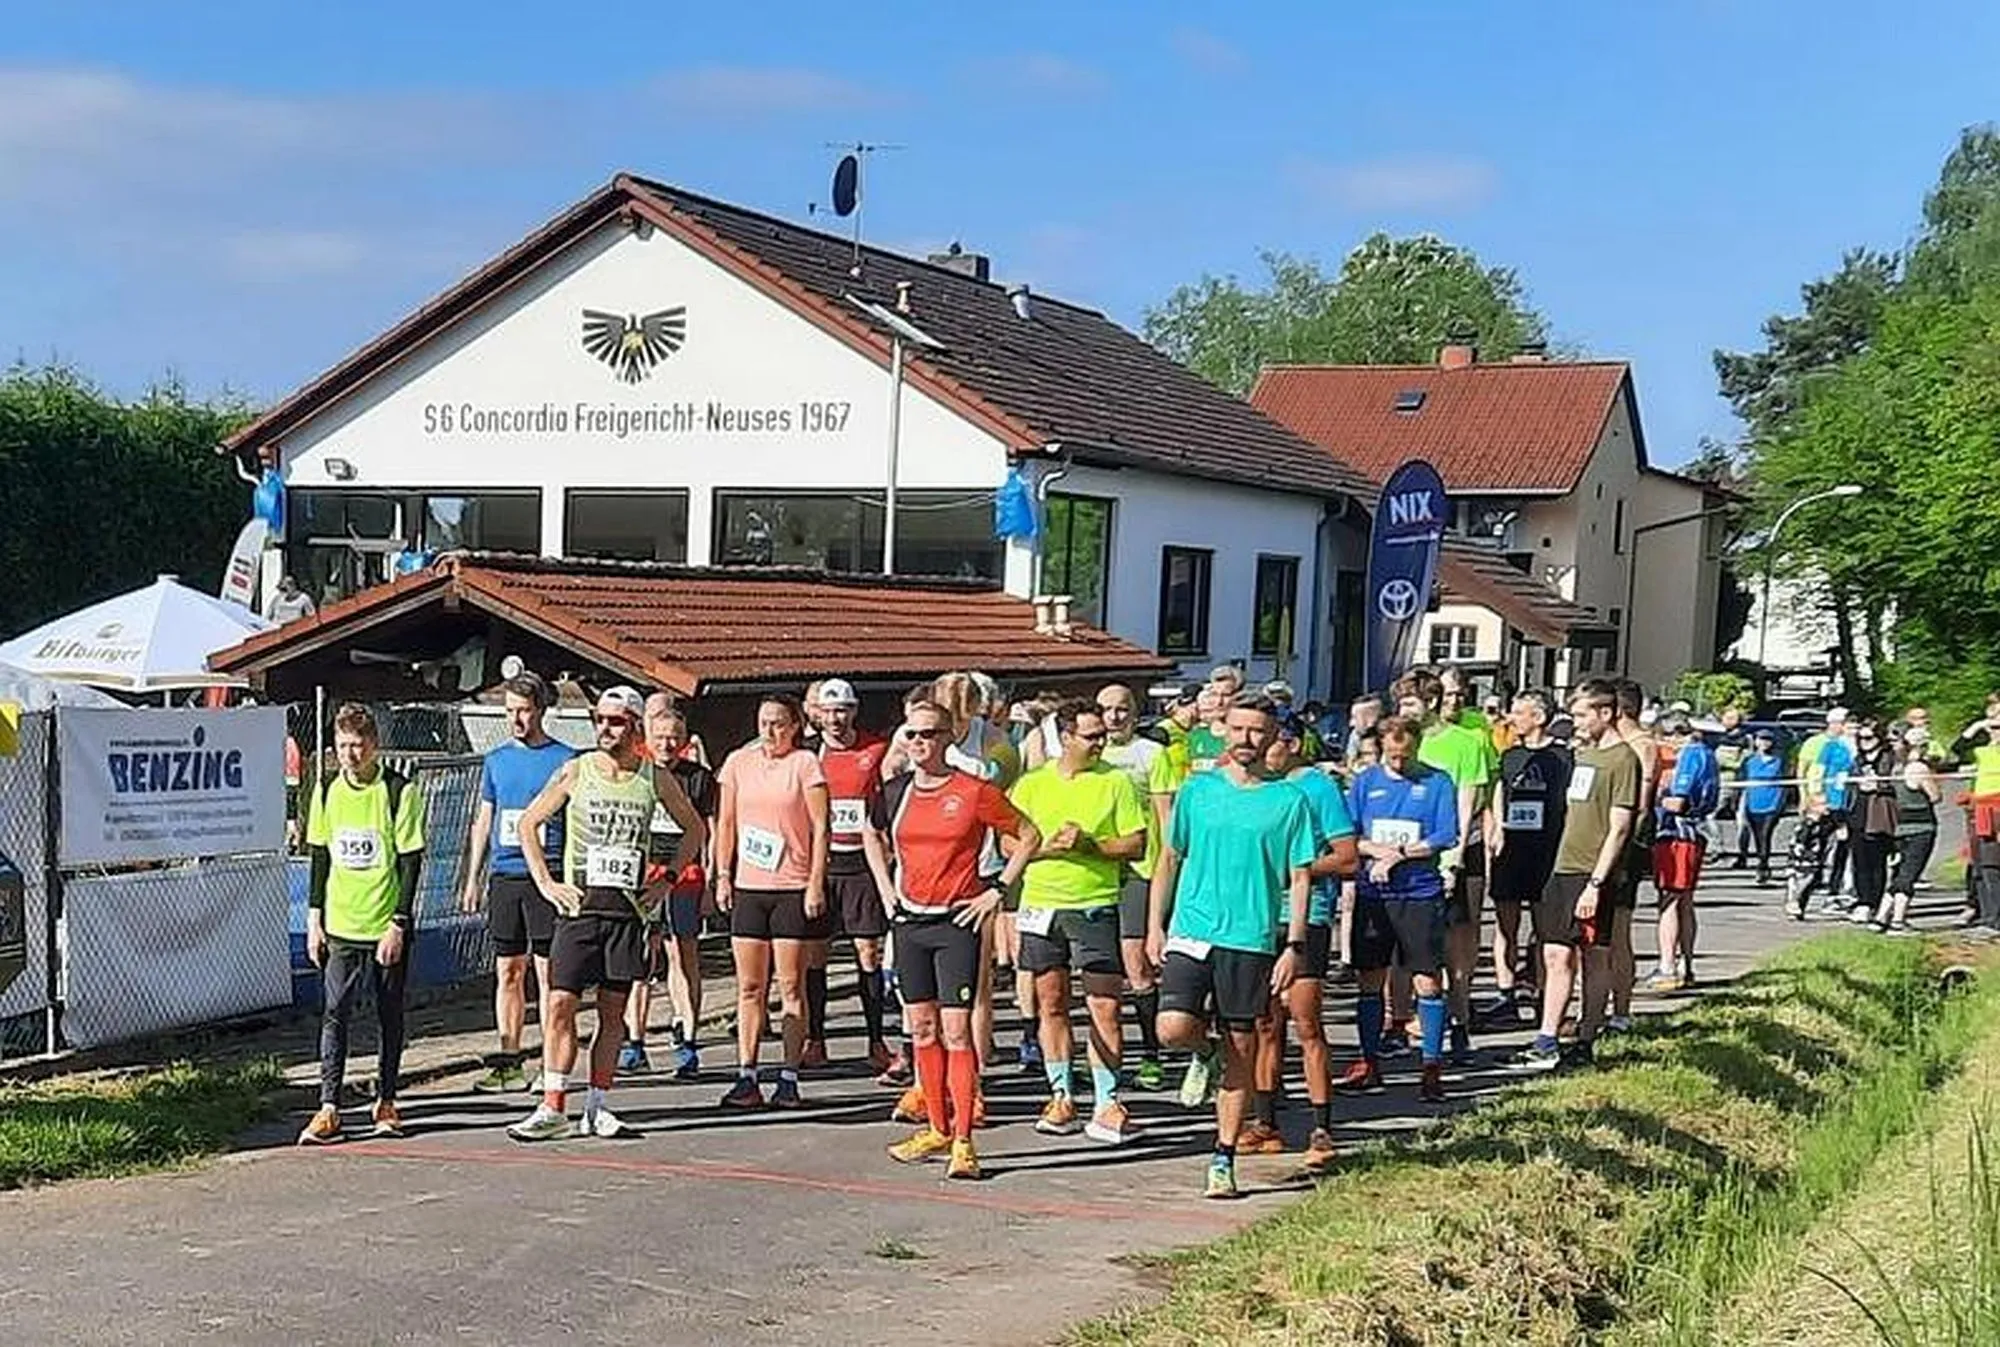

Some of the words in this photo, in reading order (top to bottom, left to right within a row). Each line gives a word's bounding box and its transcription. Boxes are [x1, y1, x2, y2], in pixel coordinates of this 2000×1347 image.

[424, 403, 453, 433] SG
[460, 402, 568, 433] Concordia
[800, 402, 851, 432] 1967
[1389, 491, 1434, 526] NIX
[107, 749, 243, 793] BENZING
[338, 839, 374, 856] 359
